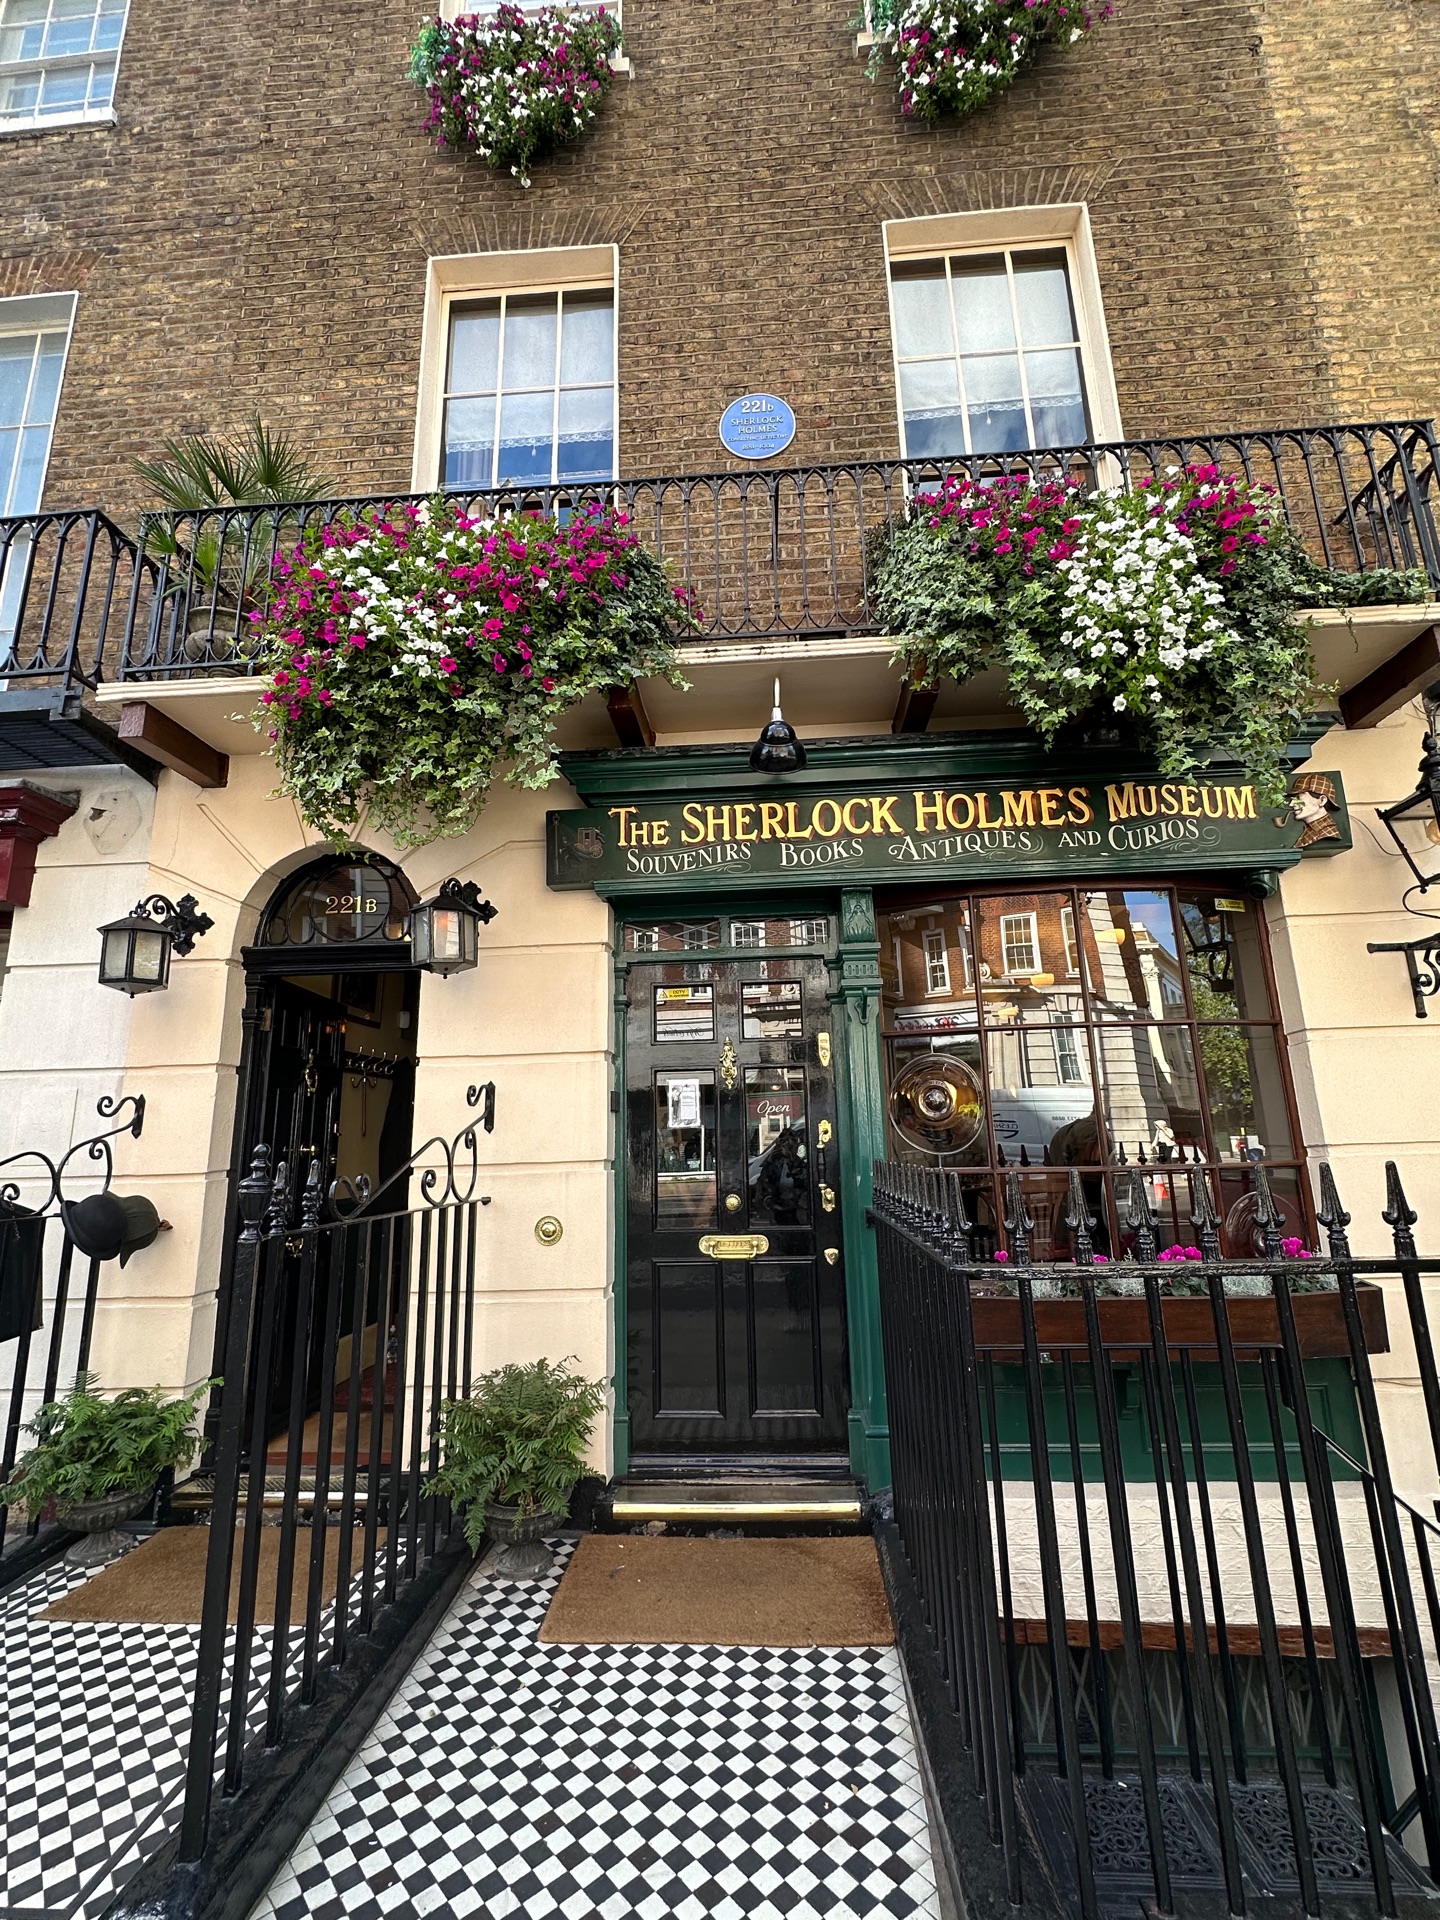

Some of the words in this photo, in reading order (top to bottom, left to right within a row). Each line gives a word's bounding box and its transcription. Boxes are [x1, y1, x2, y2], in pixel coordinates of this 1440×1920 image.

[741, 399, 774, 413] 221b
[731, 416, 783, 426] SHERLOCK
[738, 425, 778, 434] HOLMES
[680, 794, 905, 846] SHERLOCK
[915, 786, 1093, 833] HOLMES
[1104, 781, 1260, 824] MUSEUM
[626, 841, 752, 875] SOUVENIRS
[779, 838, 865, 868] BOOKS
[888, 830, 1033, 862] ANTIQUES
[1058, 831, 1102, 849] AND
[1107, 819, 1201, 852] CURIOS
[325, 895, 377, 914] 221B
[756, 1099, 791, 1115] Open
